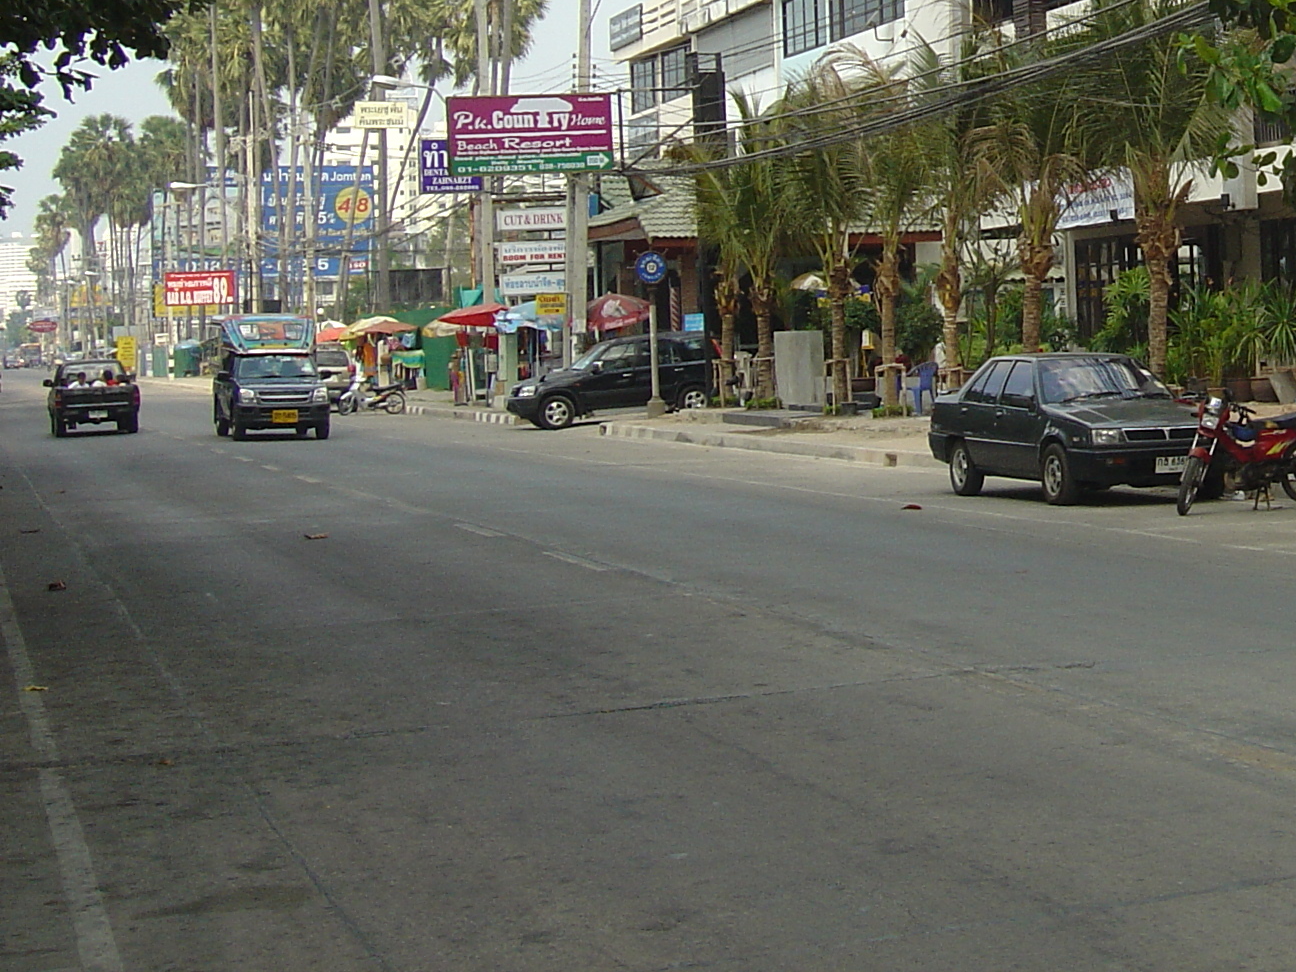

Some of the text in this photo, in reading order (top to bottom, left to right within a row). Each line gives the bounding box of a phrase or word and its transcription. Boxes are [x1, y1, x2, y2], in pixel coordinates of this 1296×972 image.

[456, 139, 498, 151] Beach
[502, 137, 572, 149] Resort
[423, 142, 449, 168] ทำ
[424, 169, 449, 177] DENTA
[533, 212, 564, 225] DRINK
